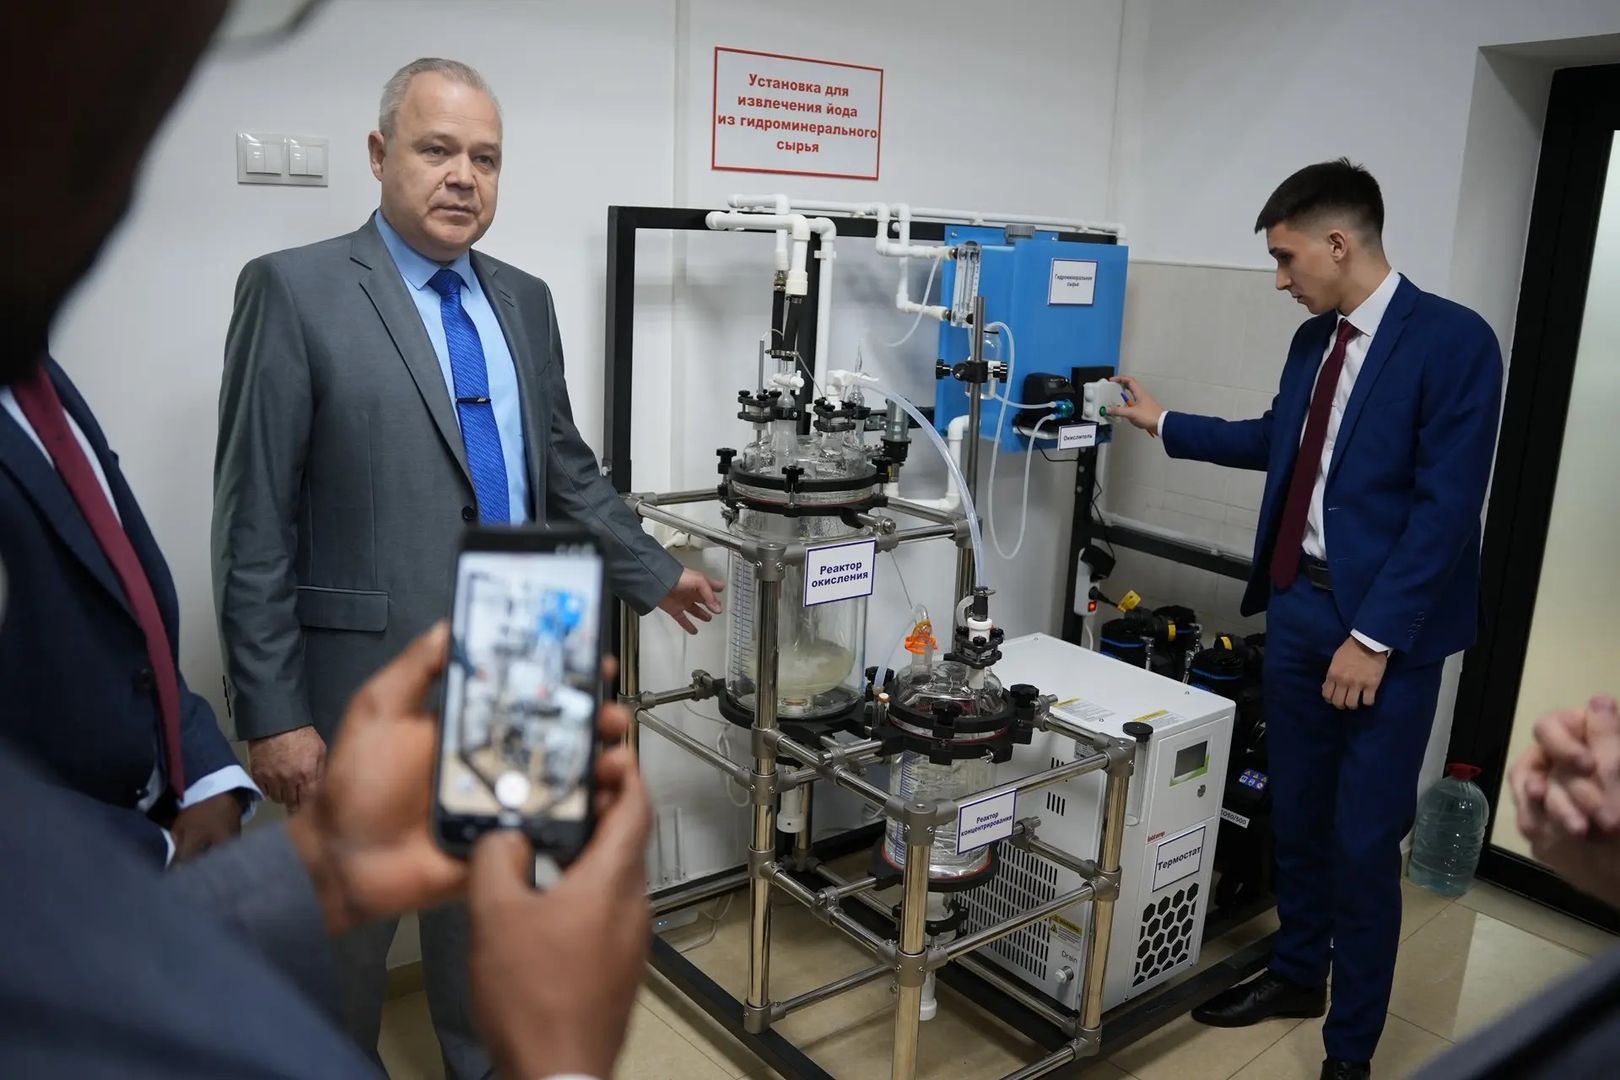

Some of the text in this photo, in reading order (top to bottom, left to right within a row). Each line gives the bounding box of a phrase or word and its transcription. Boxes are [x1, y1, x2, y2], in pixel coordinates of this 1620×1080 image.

[749, 73, 849, 97] Установка для
[737, 95, 858, 118] извлечения йода
[717, 114, 878, 139] из гидроминерального
[776, 139, 819, 154] сырья
[819, 561, 862, 575] Реактор
[811, 571, 868, 588] окисления
[961, 815, 1012, 836] концентрирования
[976, 812, 999, 824] Реактор
[1157, 846, 1201, 870] Термостат
[1062, 950, 1078, 963] Drain
